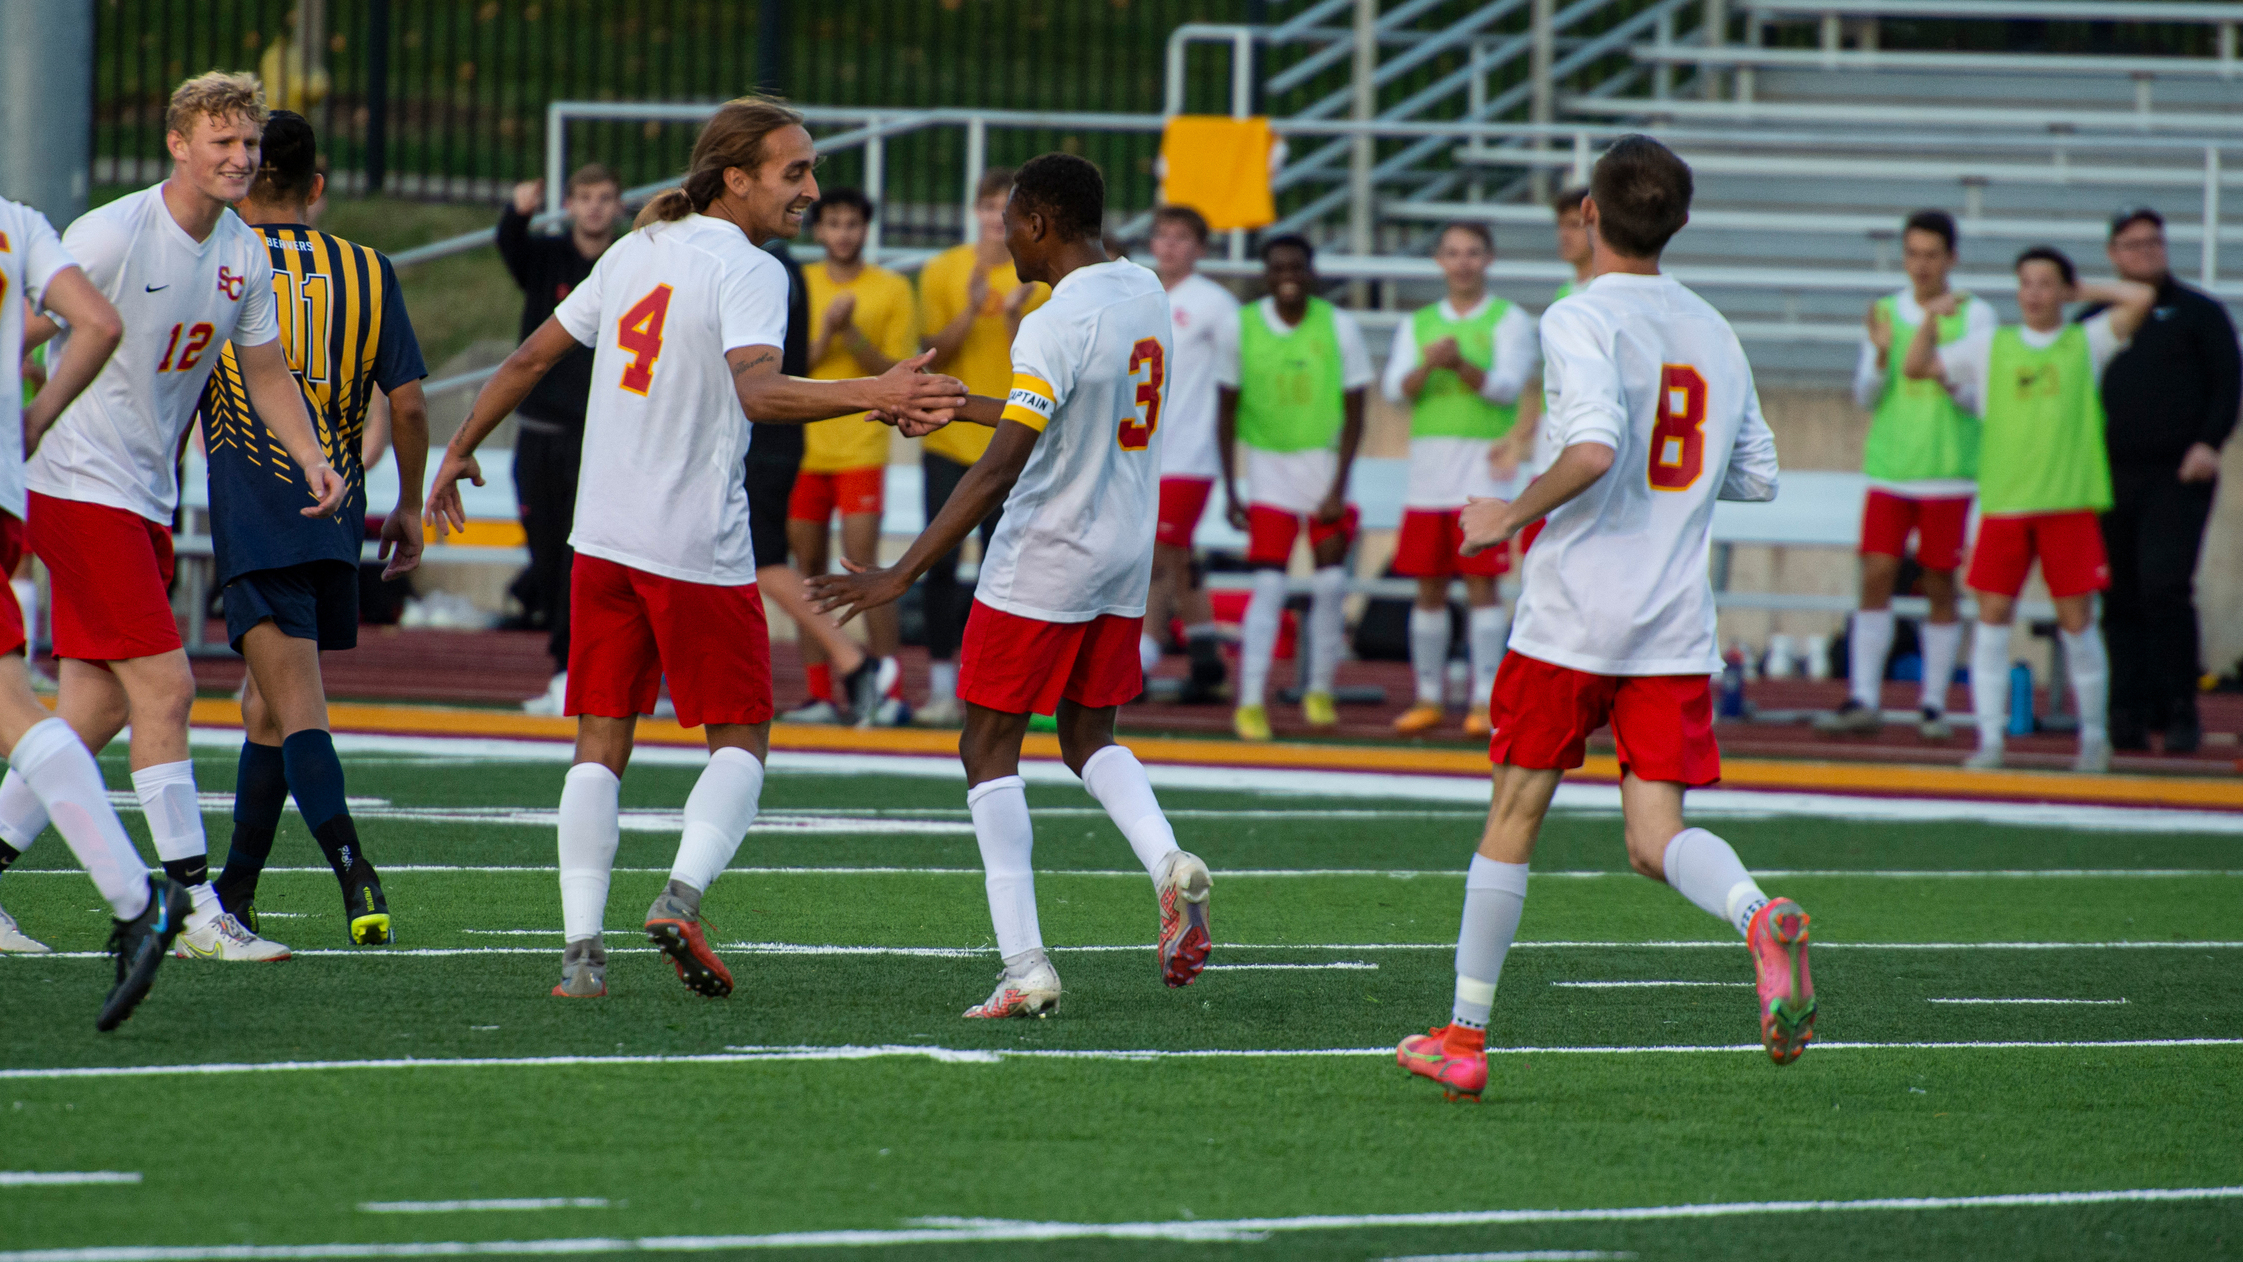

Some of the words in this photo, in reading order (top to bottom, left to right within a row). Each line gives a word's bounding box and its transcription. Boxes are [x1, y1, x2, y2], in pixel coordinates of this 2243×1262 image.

[217, 265, 245, 301] SC
[265, 236, 314, 252] BEAVERS
[157, 322, 216, 373] 12
[271, 268, 332, 384] 11
[617, 282, 674, 398] 4
[1116, 336, 1165, 452] 3
[1647, 362, 1709, 492] 8
